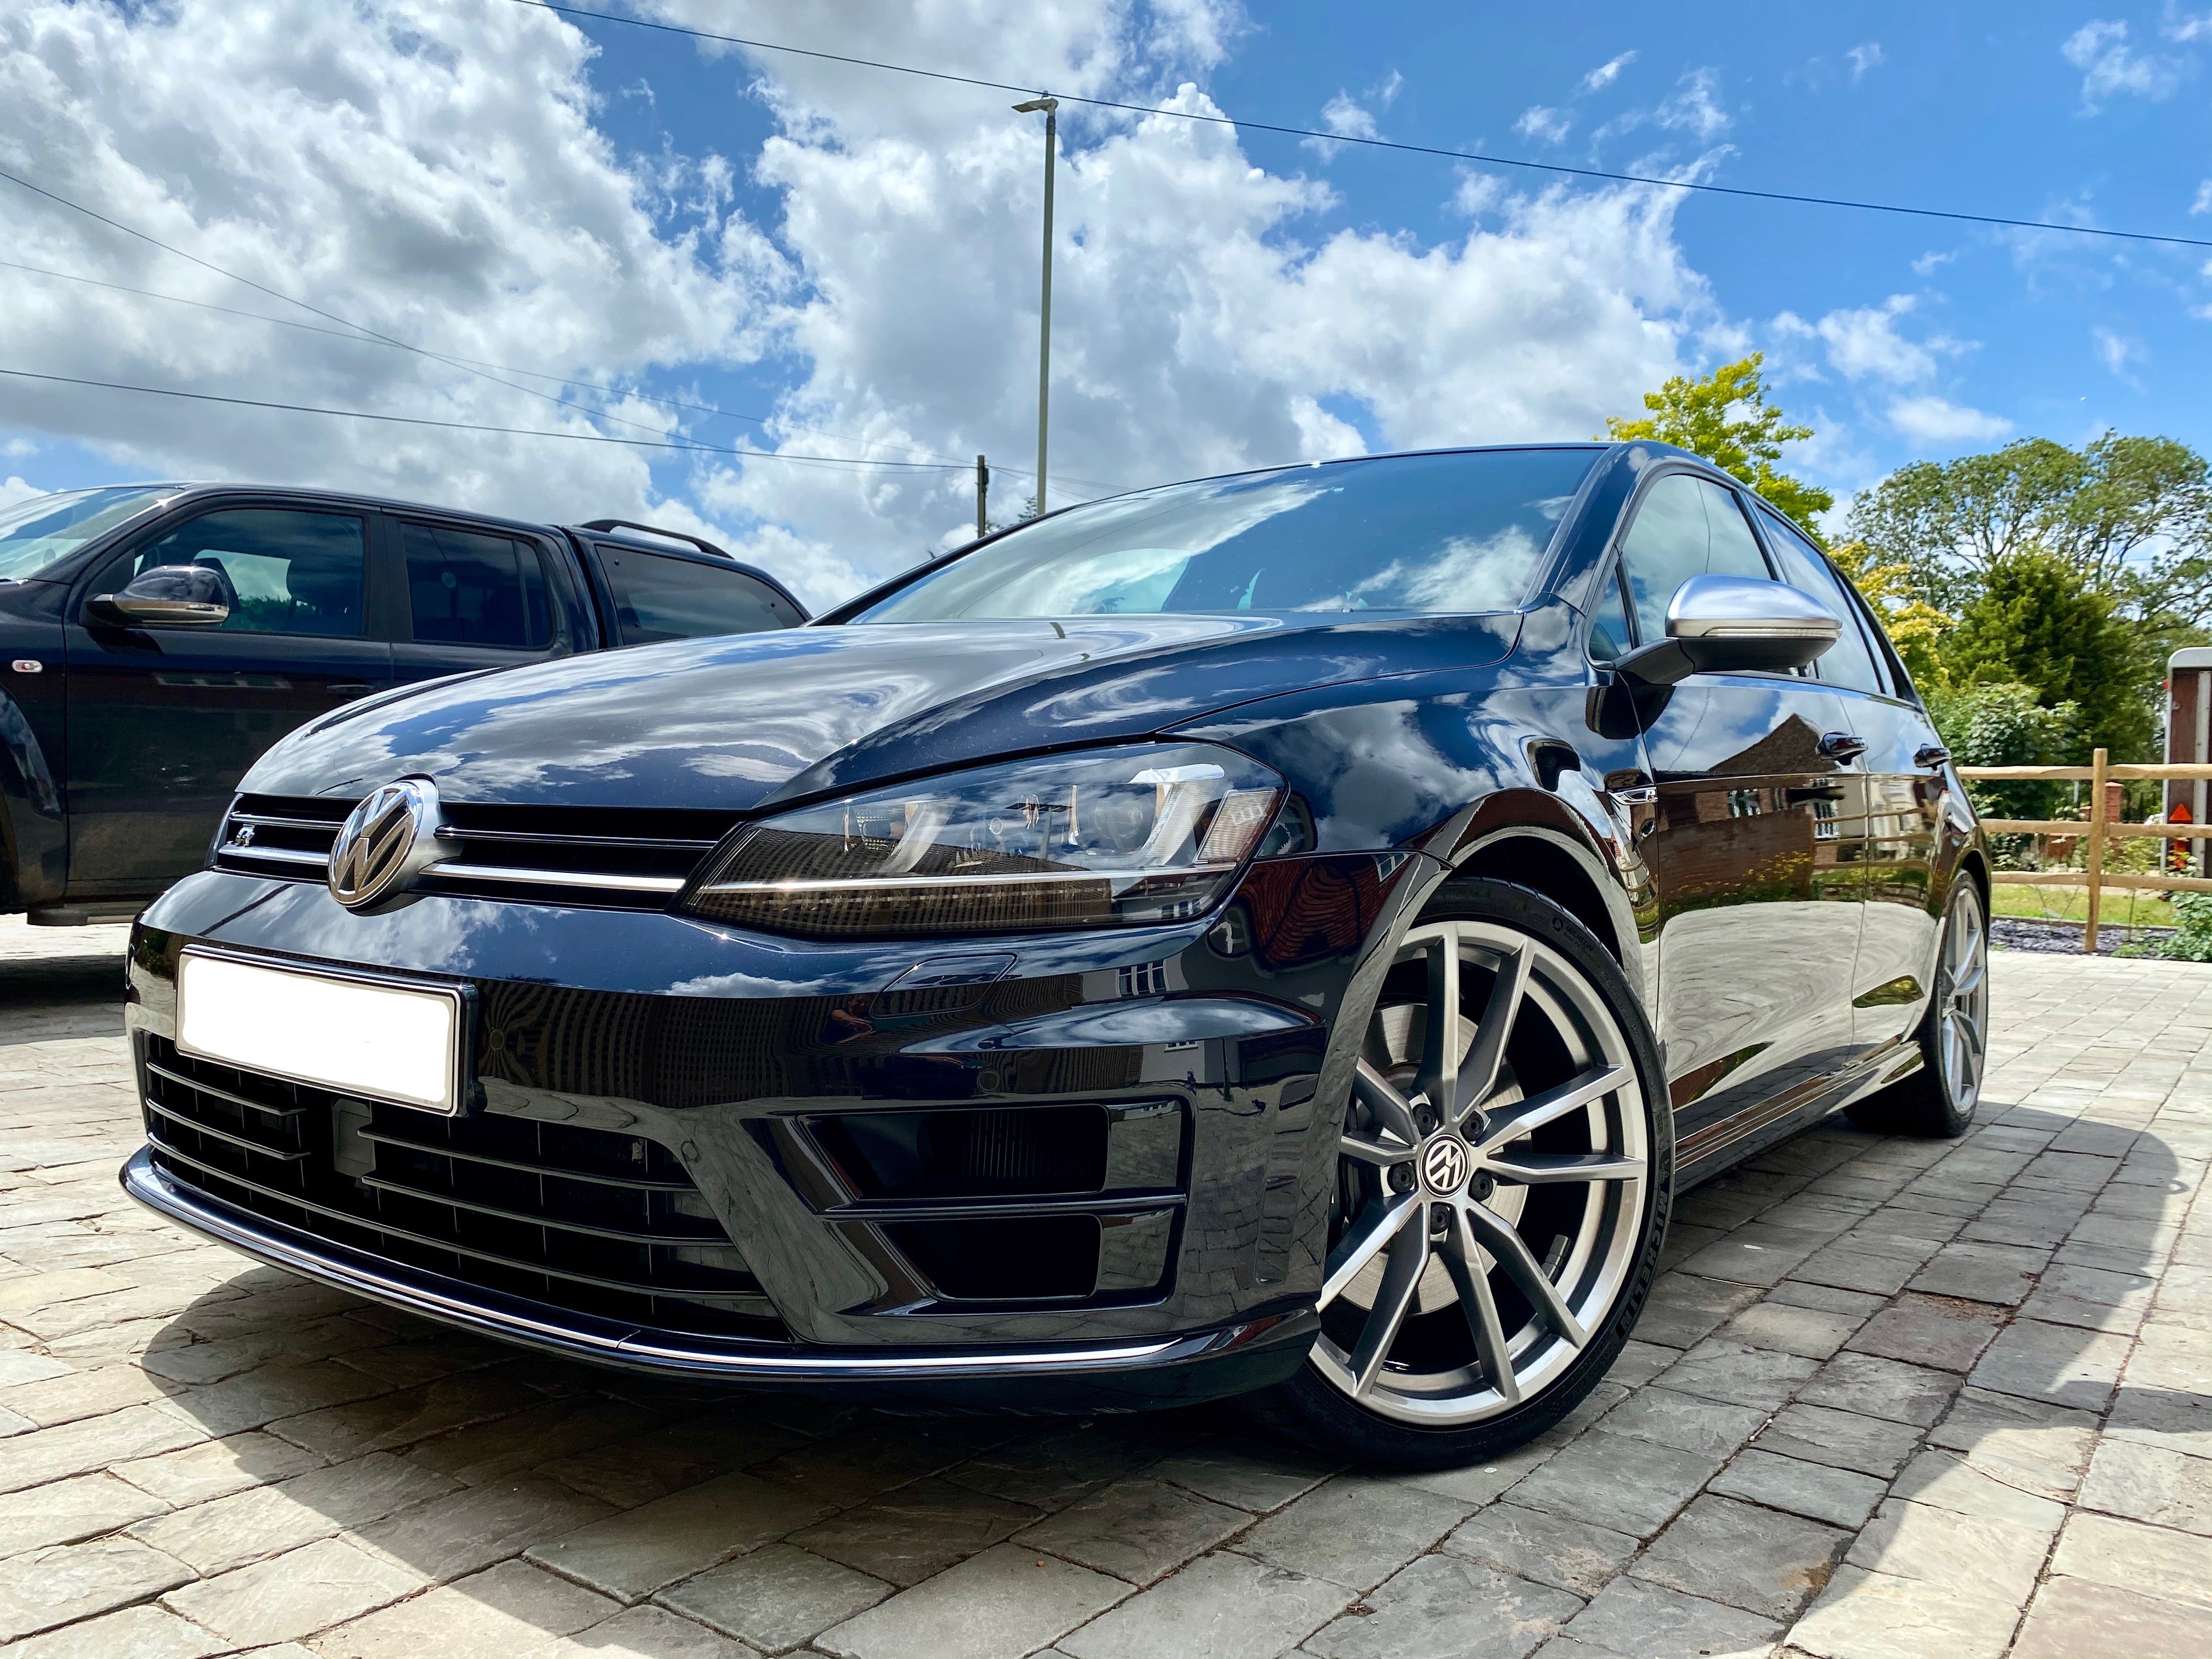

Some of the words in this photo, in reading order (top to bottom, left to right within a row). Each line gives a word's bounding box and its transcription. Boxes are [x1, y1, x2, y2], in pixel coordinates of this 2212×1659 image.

[330, 781, 424, 907] VW
[1567, 926, 1594, 951] MICHELIN
[1423, 1137, 1468, 1194] VW
[1620, 1190, 1668, 1331] MICHELIN
